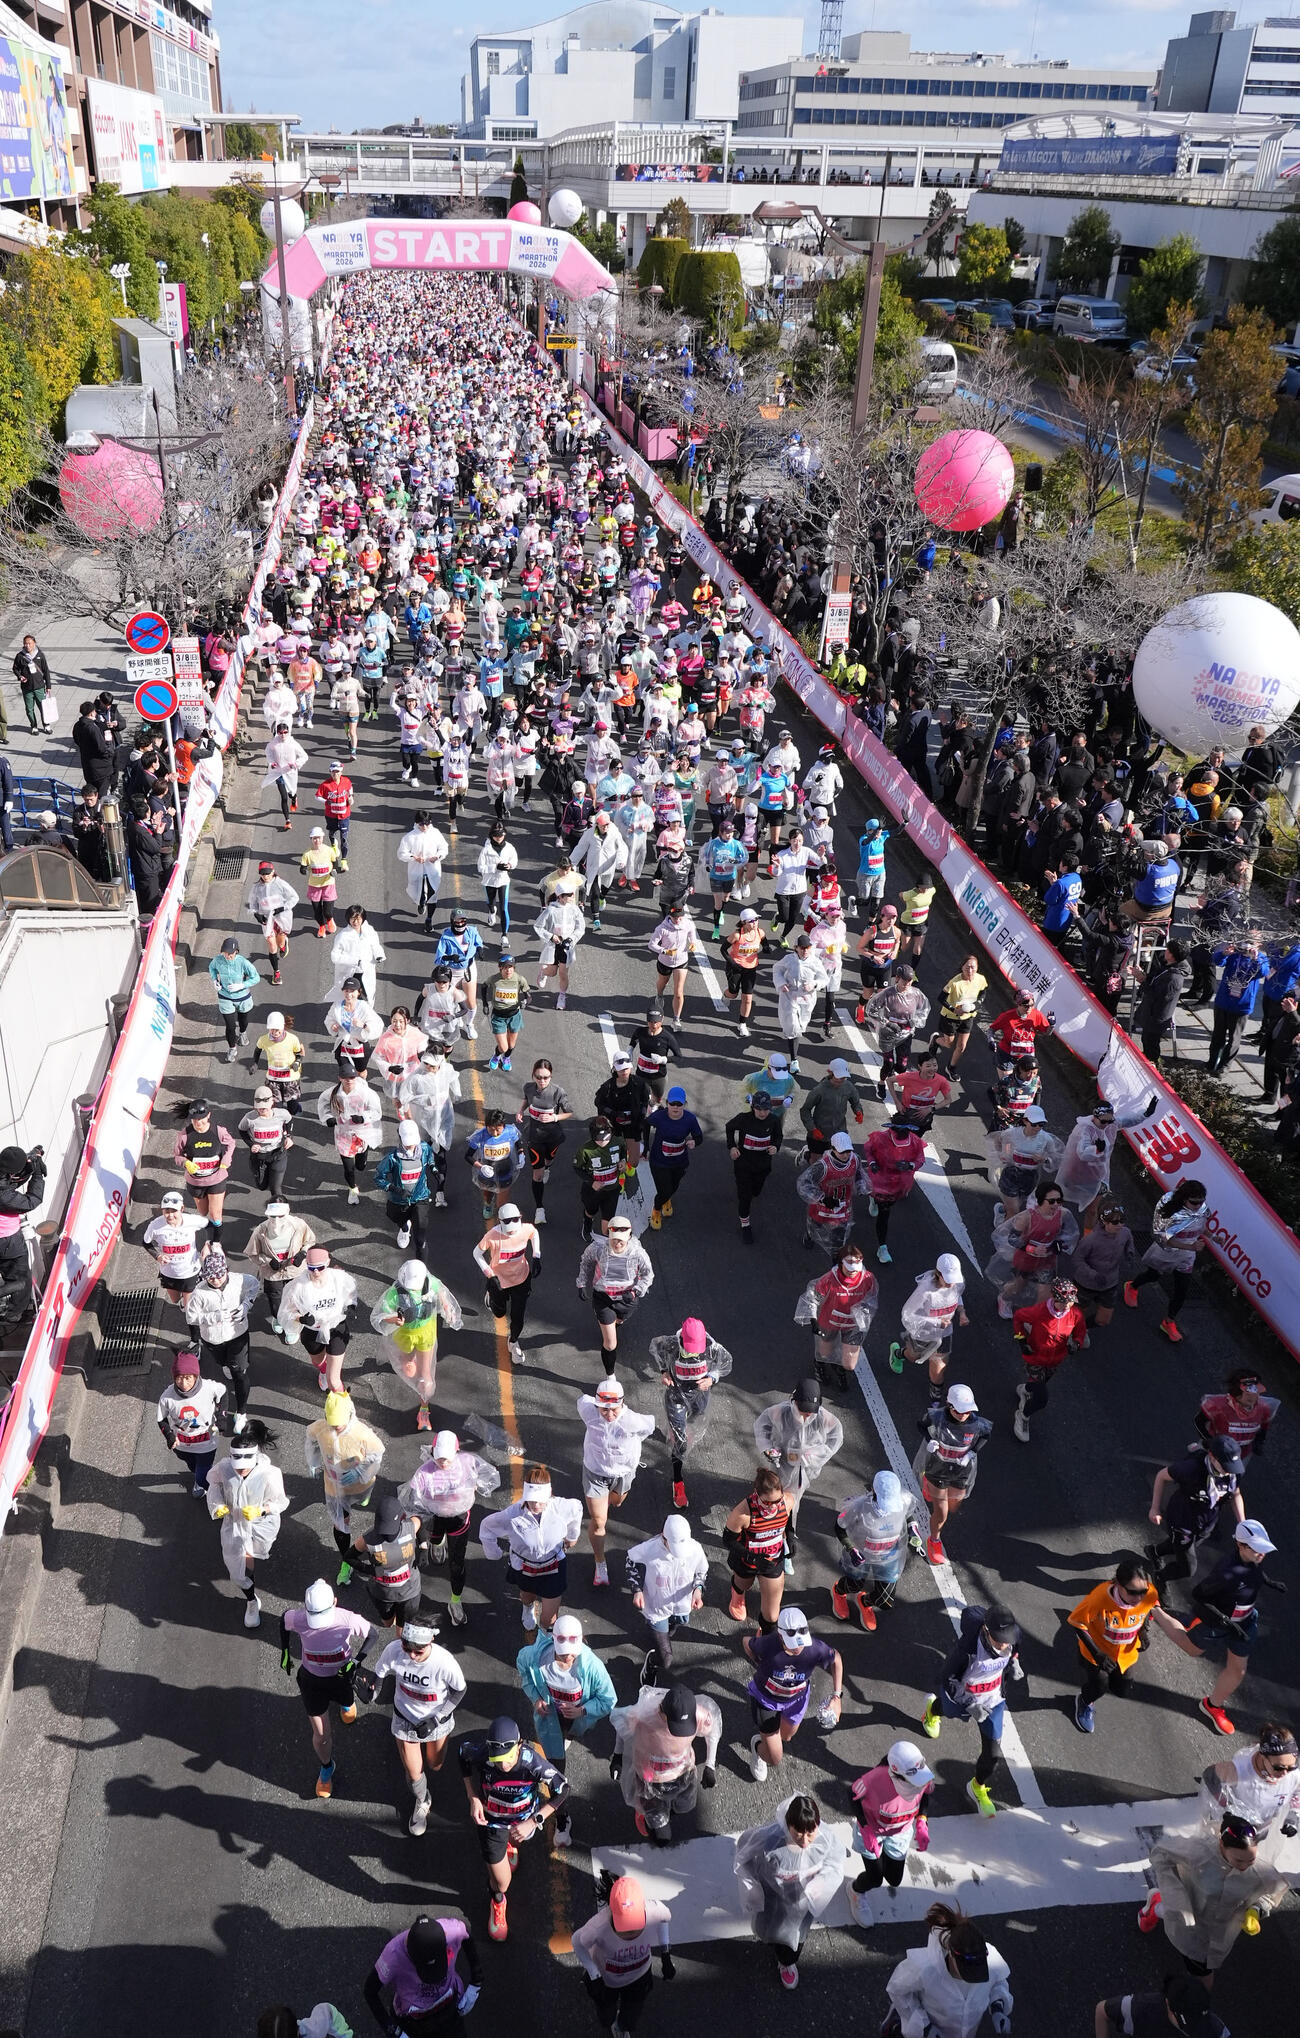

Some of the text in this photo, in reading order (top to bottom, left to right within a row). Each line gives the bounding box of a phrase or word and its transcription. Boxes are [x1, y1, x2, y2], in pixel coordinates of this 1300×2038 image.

[120, 120, 138, 161] JINS
[1084, 150, 1122, 164] DRAGONS
[644, 170, 654, 178] WE
[374, 230, 506, 263] START
[324, 251, 364, 259] MARATHON
[335, 258, 354, 266] 2026
[519, 253, 558, 262] MARATHON
[529, 260, 547, 268] 2026
[128, 656, 169, 669] 野球開催日
[132, 666, 168, 678] 17-23
[1210, 662, 1281, 696] NAGOYA
[1213, 683, 1275, 709] WOMEN'S
[1196, 692, 1270, 720] MARATHON
[1211, 710, 1245, 727] 2026
[961, 881, 1000, 934] Niterra
[995, 927, 1052, 997] 日本特殊陶業
[1205, 1209, 1272, 1299] balance
[403, 1671, 430, 1687] HDC
